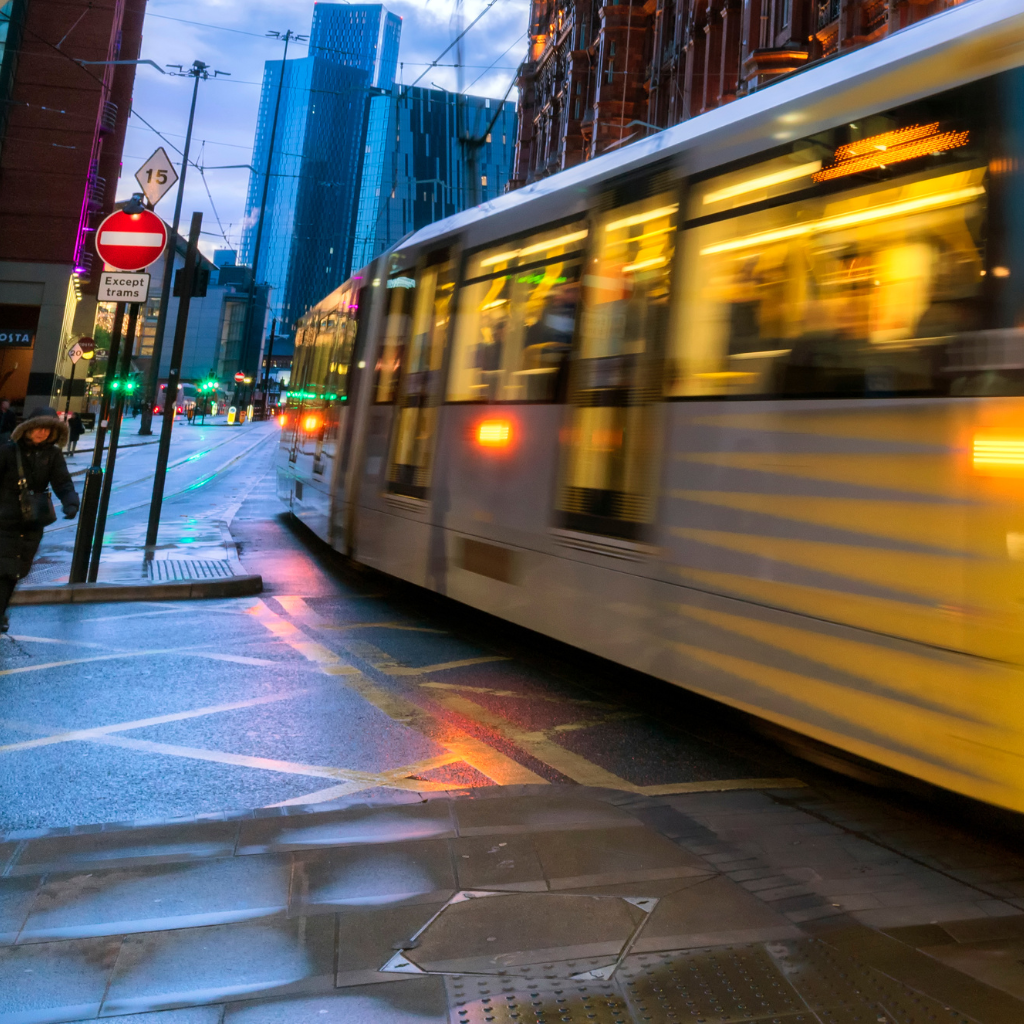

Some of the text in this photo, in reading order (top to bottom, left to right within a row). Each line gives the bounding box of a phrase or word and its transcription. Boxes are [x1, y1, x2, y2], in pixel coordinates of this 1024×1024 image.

[145, 169, 168, 185] 15
[105, 277, 145, 288] Except
[106, 288, 139, 298] trams
